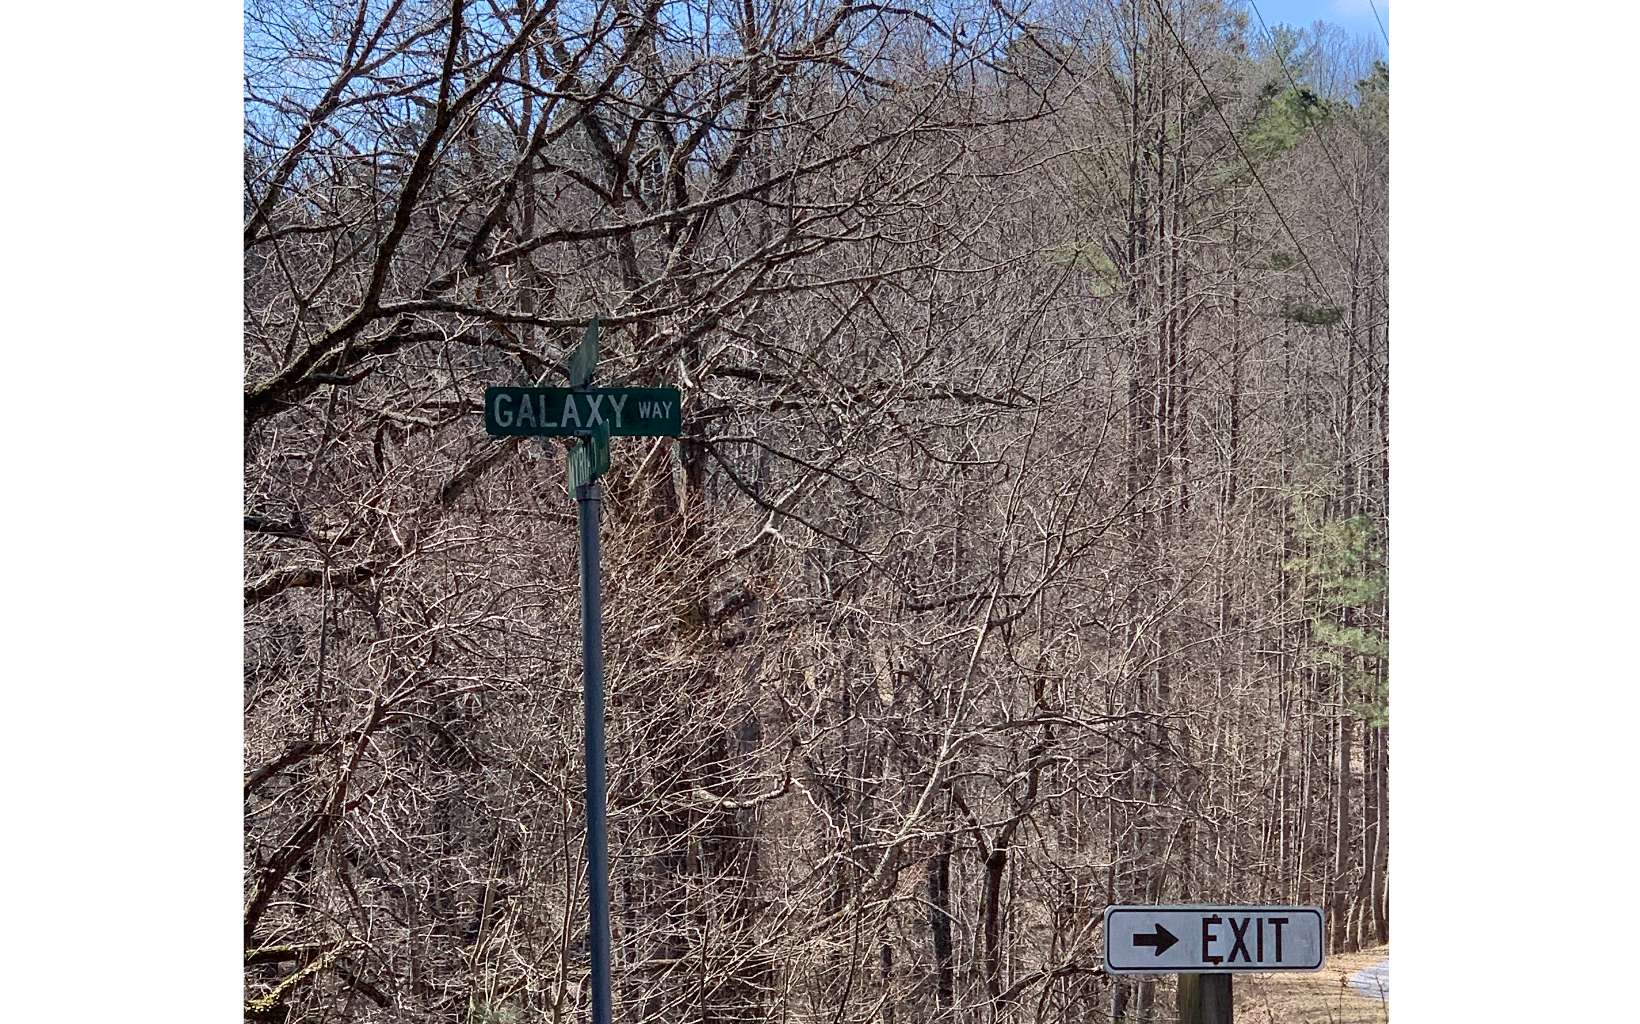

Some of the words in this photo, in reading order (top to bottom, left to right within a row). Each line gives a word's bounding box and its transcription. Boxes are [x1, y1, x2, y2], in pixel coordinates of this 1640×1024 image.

[494, 394, 628, 428] GALAXY
[638, 401, 673, 419] WAY
[1202, 917, 1289, 963] EXIT
